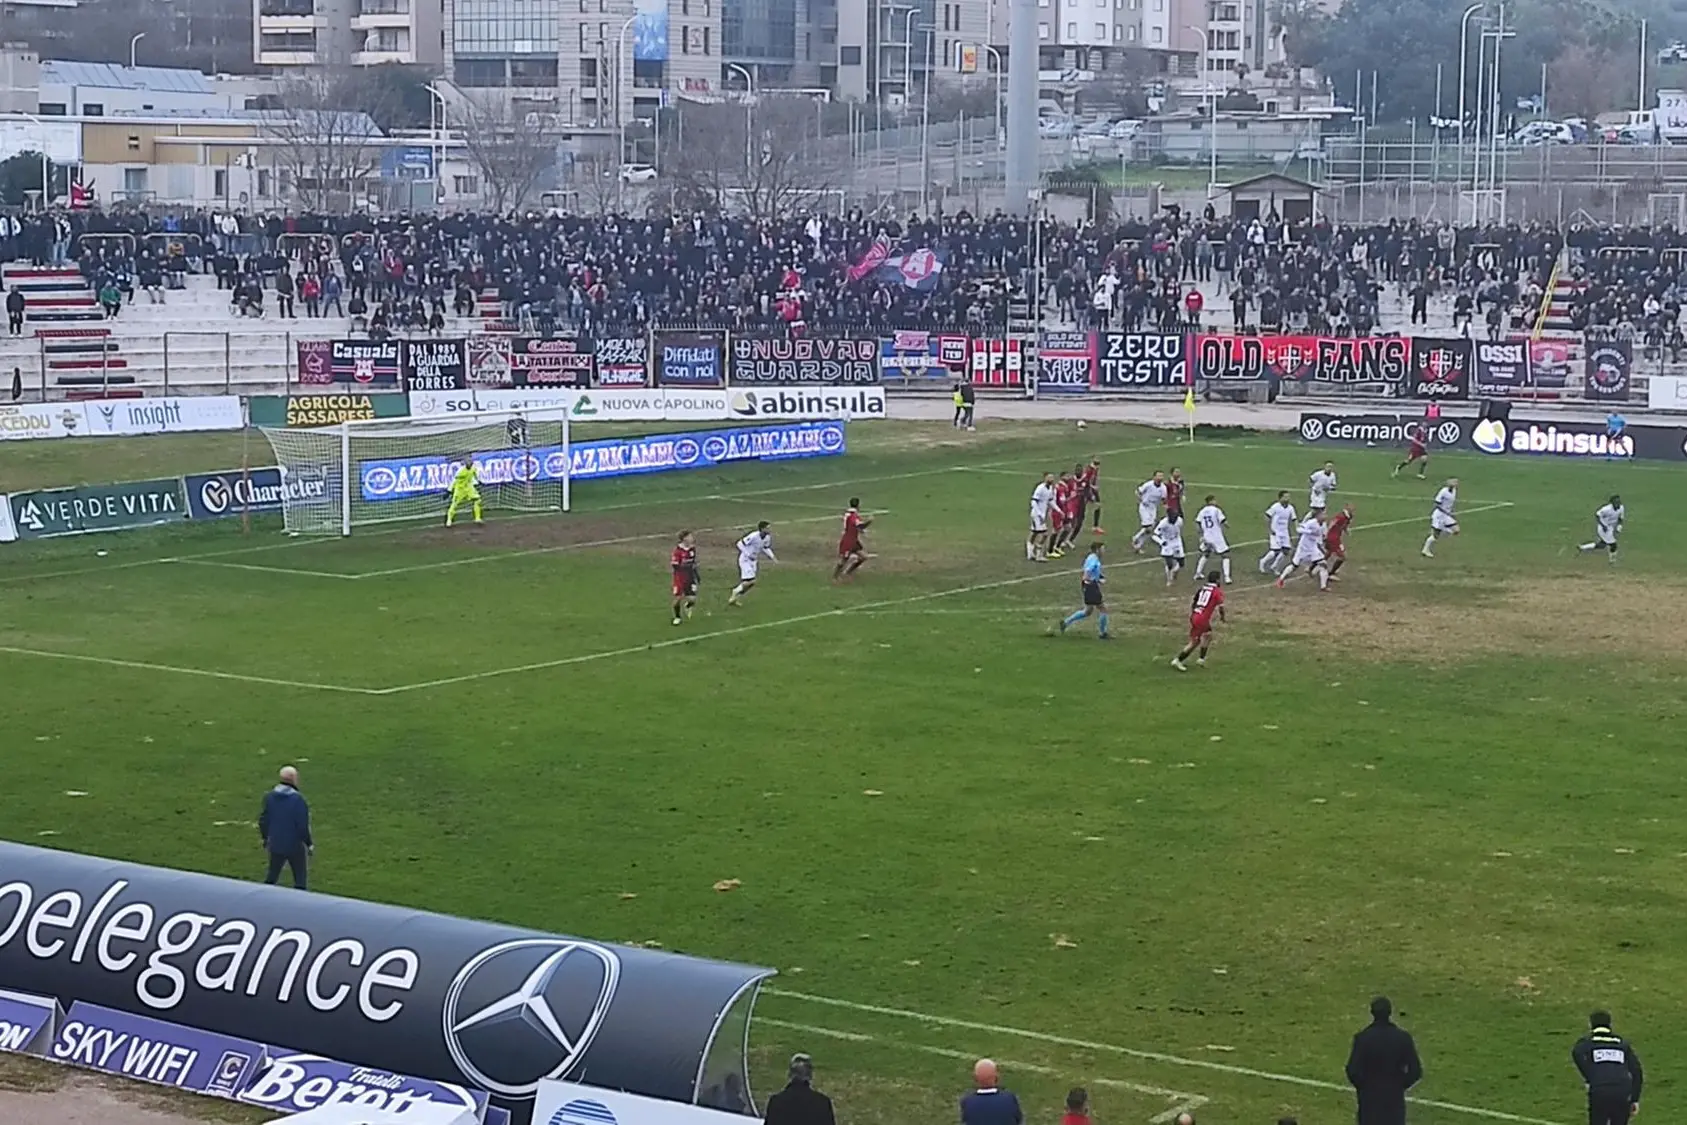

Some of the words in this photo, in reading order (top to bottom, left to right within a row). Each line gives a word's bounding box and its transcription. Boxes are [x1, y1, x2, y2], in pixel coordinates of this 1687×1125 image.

[333, 342, 397, 358] Casuals
[409, 344, 429, 355] DAL
[432, 344, 456, 354] 1989
[664, 346, 714, 362] Diffidati
[1107, 334, 1180, 358] ZERO
[1480, 345, 1523, 363] OSSI
[409, 355, 416, 367] A
[417, 353, 460, 366] GUARDIA
[972, 352, 1022, 370] BFB
[1200, 337, 1264, 379] OLD
[1315, 338, 1405, 383] FANS
[417, 366, 442, 377] DELLA
[665, 366, 689, 378] con
[695, 363, 713, 377] noi
[735, 360, 874, 381] GUARDIA
[1100, 359, 1186, 384] TESTA
[408, 376, 456, 389] TORRES
[287, 396, 372, 410] AGRICOLA
[602, 400, 649, 410] NUOVA
[653, 399, 726, 410] CAPOLINO
[761, 391, 884, 414] abinsula
[0, 414, 51, 431] CEDDU
[127, 399, 182, 430] insight
[287, 409, 375, 424] SASSARESE
[1326, 421, 1436, 443] GermanCr
[727, 434, 750, 459] AZ
[751, 429, 820, 456] RICAMBI
[570, 452, 597, 475] AZ
[598, 441, 676, 472] RICAMBI
[395, 465, 425, 492] AZ
[426, 456, 514, 491] RICMBI
[234, 478, 325, 504] Character
[43, 497, 117, 521] VERDE
[122, 494, 176, 514] VITA
[1204, 515, 1214, 528] 13
[1196, 589, 1212, 607] 10
[54, 1022, 128, 1067] SKY
[121, 1036, 198, 1086] WIFI
[349, 1066, 406, 1089] Fratelli
